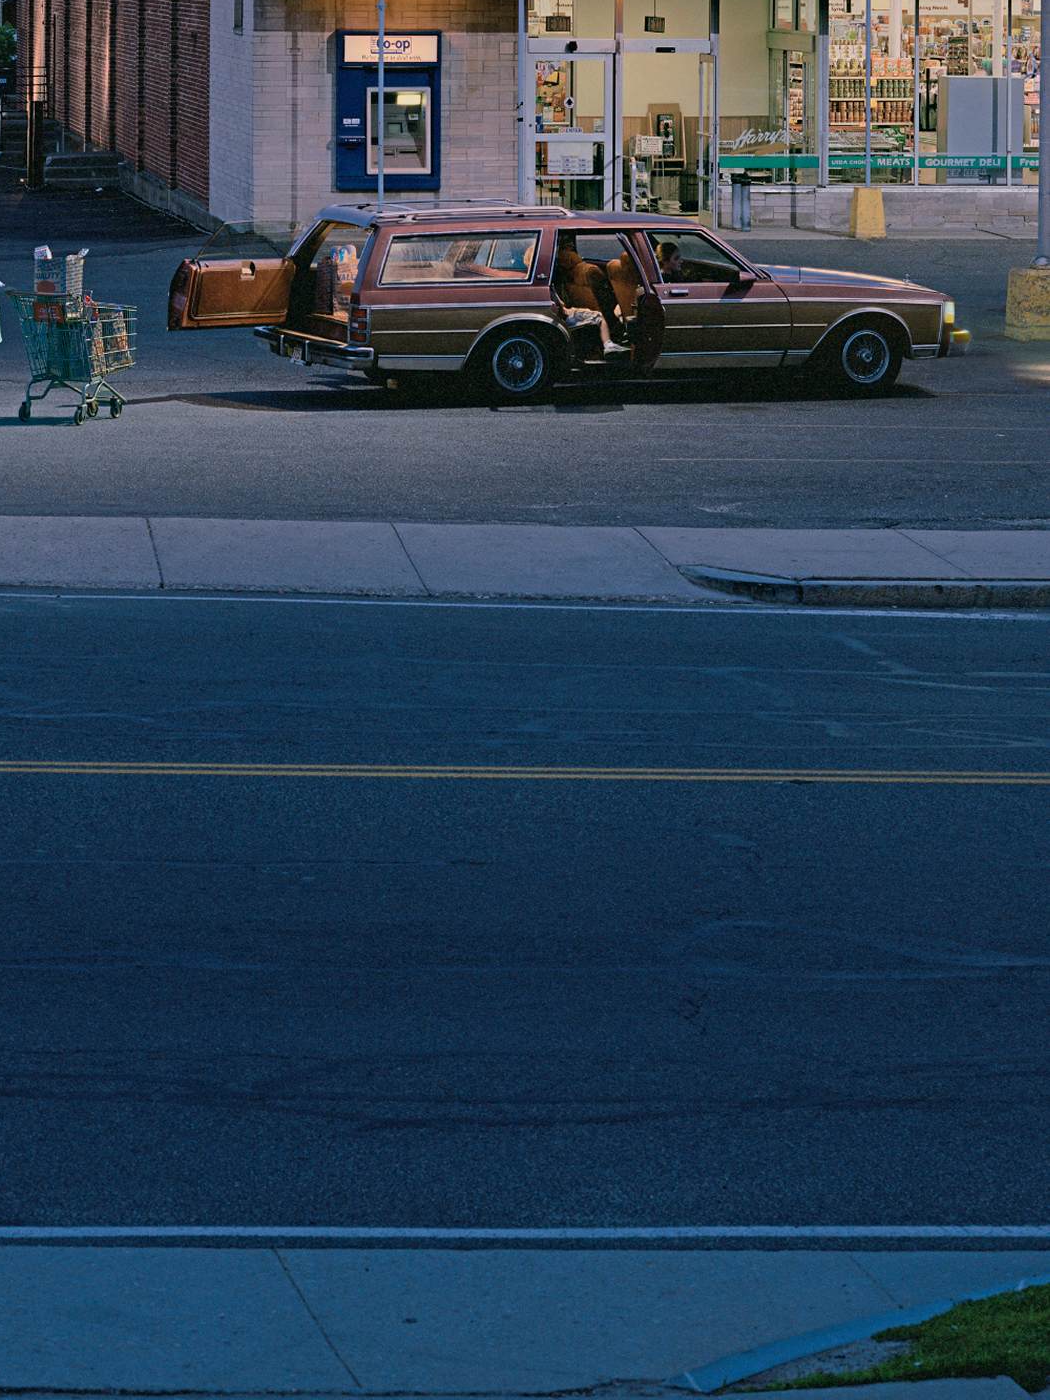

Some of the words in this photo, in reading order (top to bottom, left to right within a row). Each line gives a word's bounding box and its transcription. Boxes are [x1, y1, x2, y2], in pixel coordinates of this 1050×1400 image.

[877, 158, 910, 166] MEATS
[925, 158, 975, 167] GOURMET
[979, 158, 1000, 167] DELI
[1019, 158, 1039, 167] Fres
